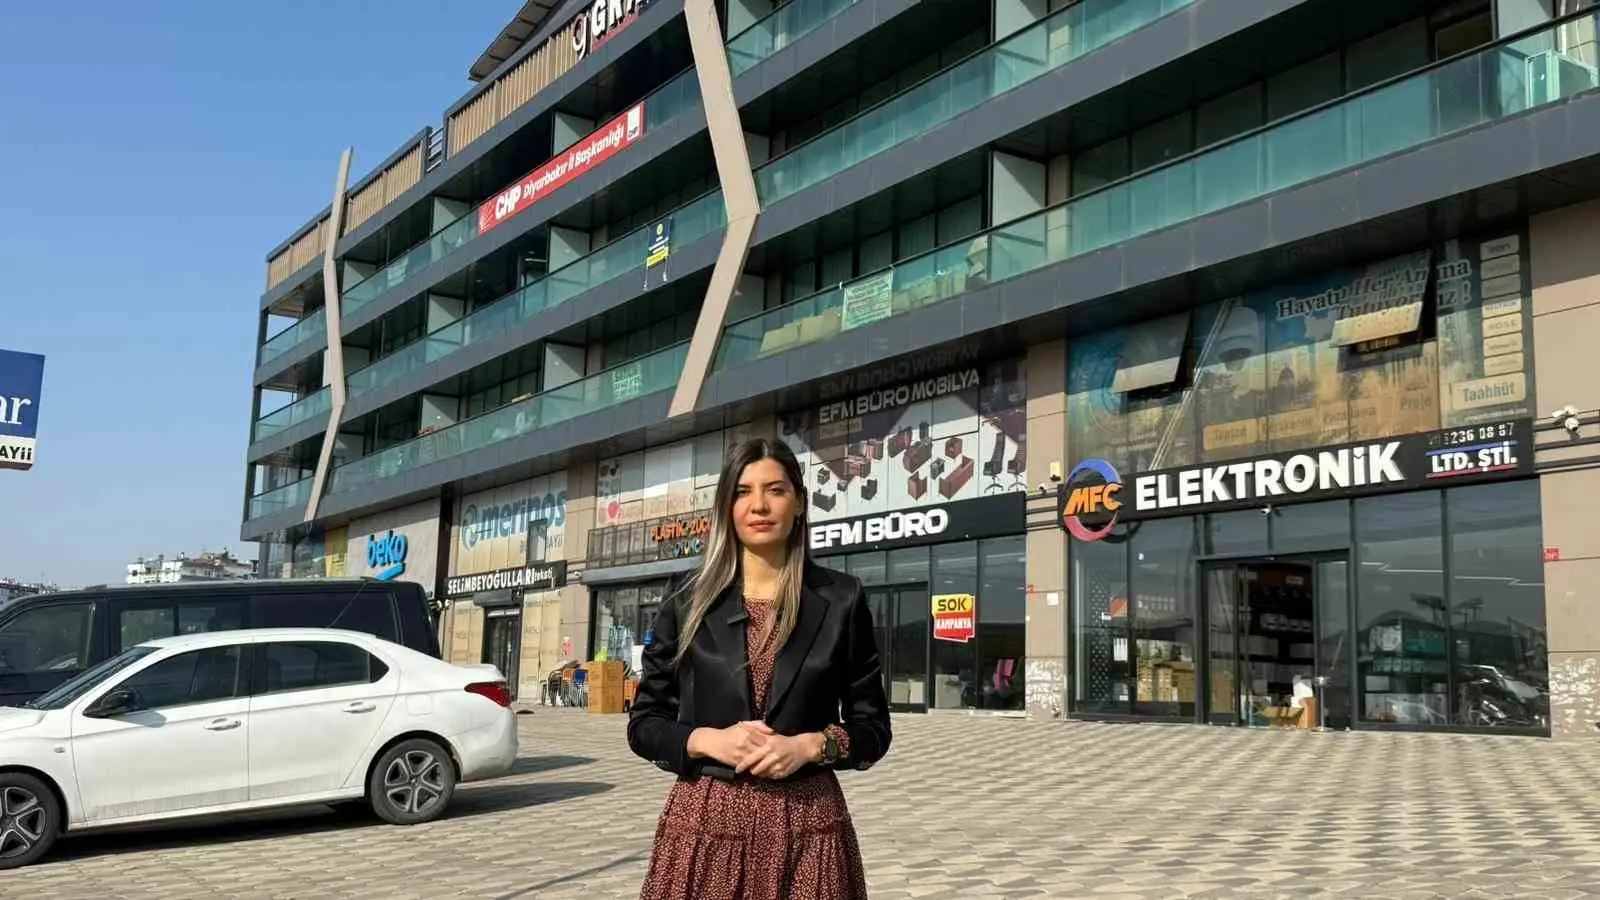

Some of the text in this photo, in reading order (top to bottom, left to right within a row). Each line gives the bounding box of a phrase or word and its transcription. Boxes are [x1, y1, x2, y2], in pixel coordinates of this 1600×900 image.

[495, 185, 522, 219] CHP
[523, 161, 568, 200] Diyarbakır
[575, 123, 624, 166] Başkanlığı
[819, 399, 856, 424] EFM
[857, 387, 910, 414] BÜRO
[1431, 452, 1474, 473] LTD.
[1063, 483, 1124, 516] MFC
[810, 508, 949, 549] EFM BÜRO
[367, 530, 408, 568] beko
